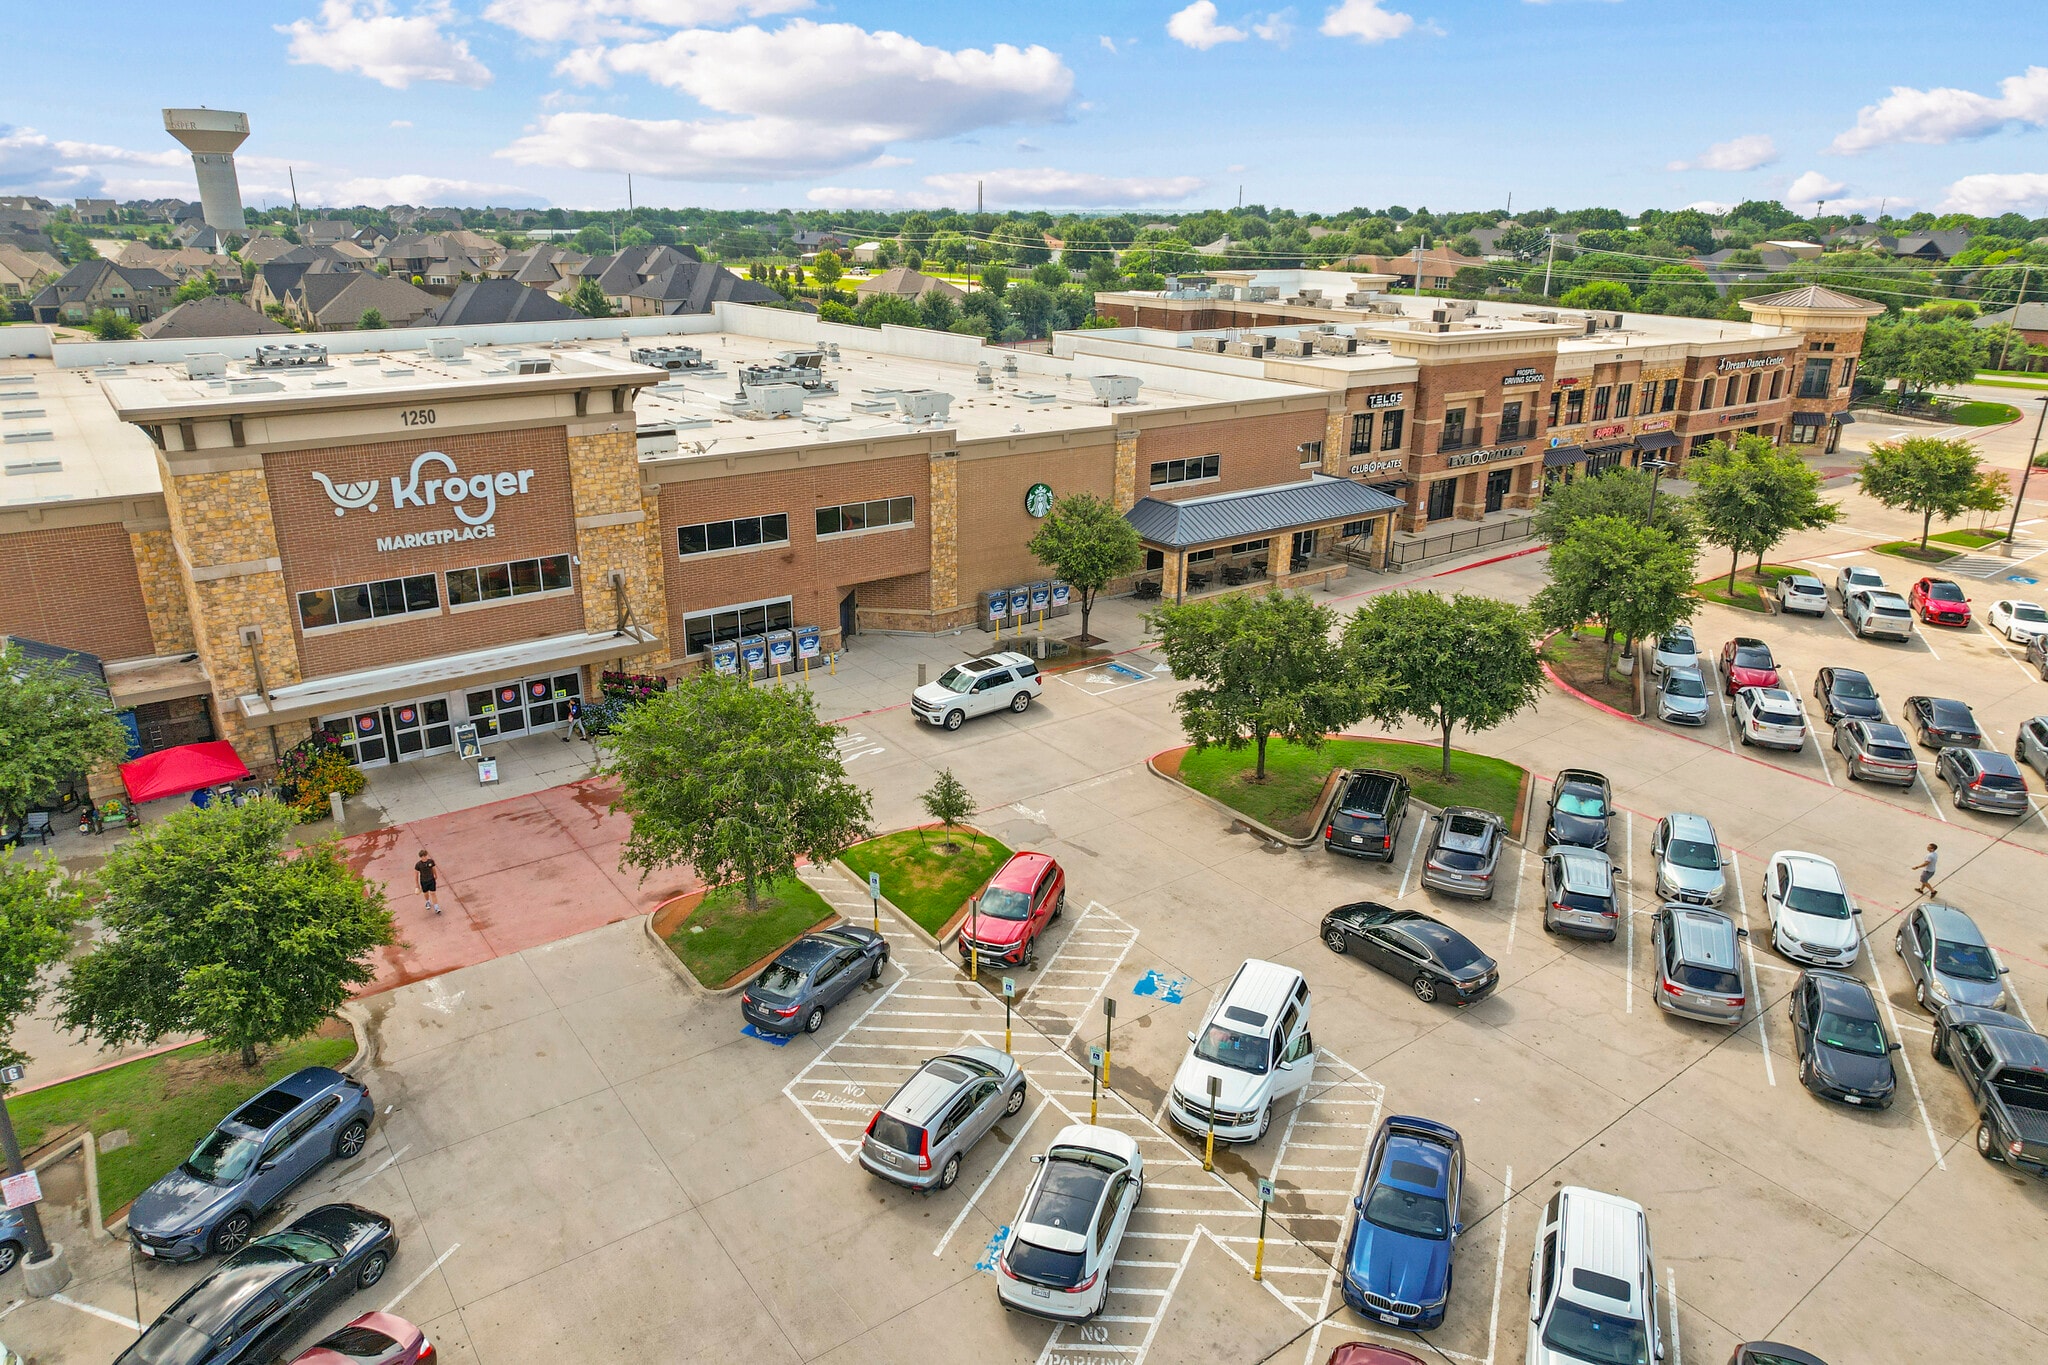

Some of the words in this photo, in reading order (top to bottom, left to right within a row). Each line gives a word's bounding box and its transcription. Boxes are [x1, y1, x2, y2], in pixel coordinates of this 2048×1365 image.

[1725, 360, 1746, 371] Dream
[1747, 358, 1765, 368] Dance
[1765, 356, 1785, 366] Center
[1504, 376, 1525, 385] DRIVING
[1525, 374, 1545, 383] SCHOOL
[1370, 393, 1403, 405] TELOS
[400, 408, 437, 427] 1250
[1351, 464, 1369, 474] CLUB
[1376, 458, 1402, 470] PILATES
[390, 451, 535, 525] Kroger
[376, 524, 496, 552] MARKETPLACE
[842, 1083, 866, 1098] NO
[1080, 1325, 1108, 1342] NO
